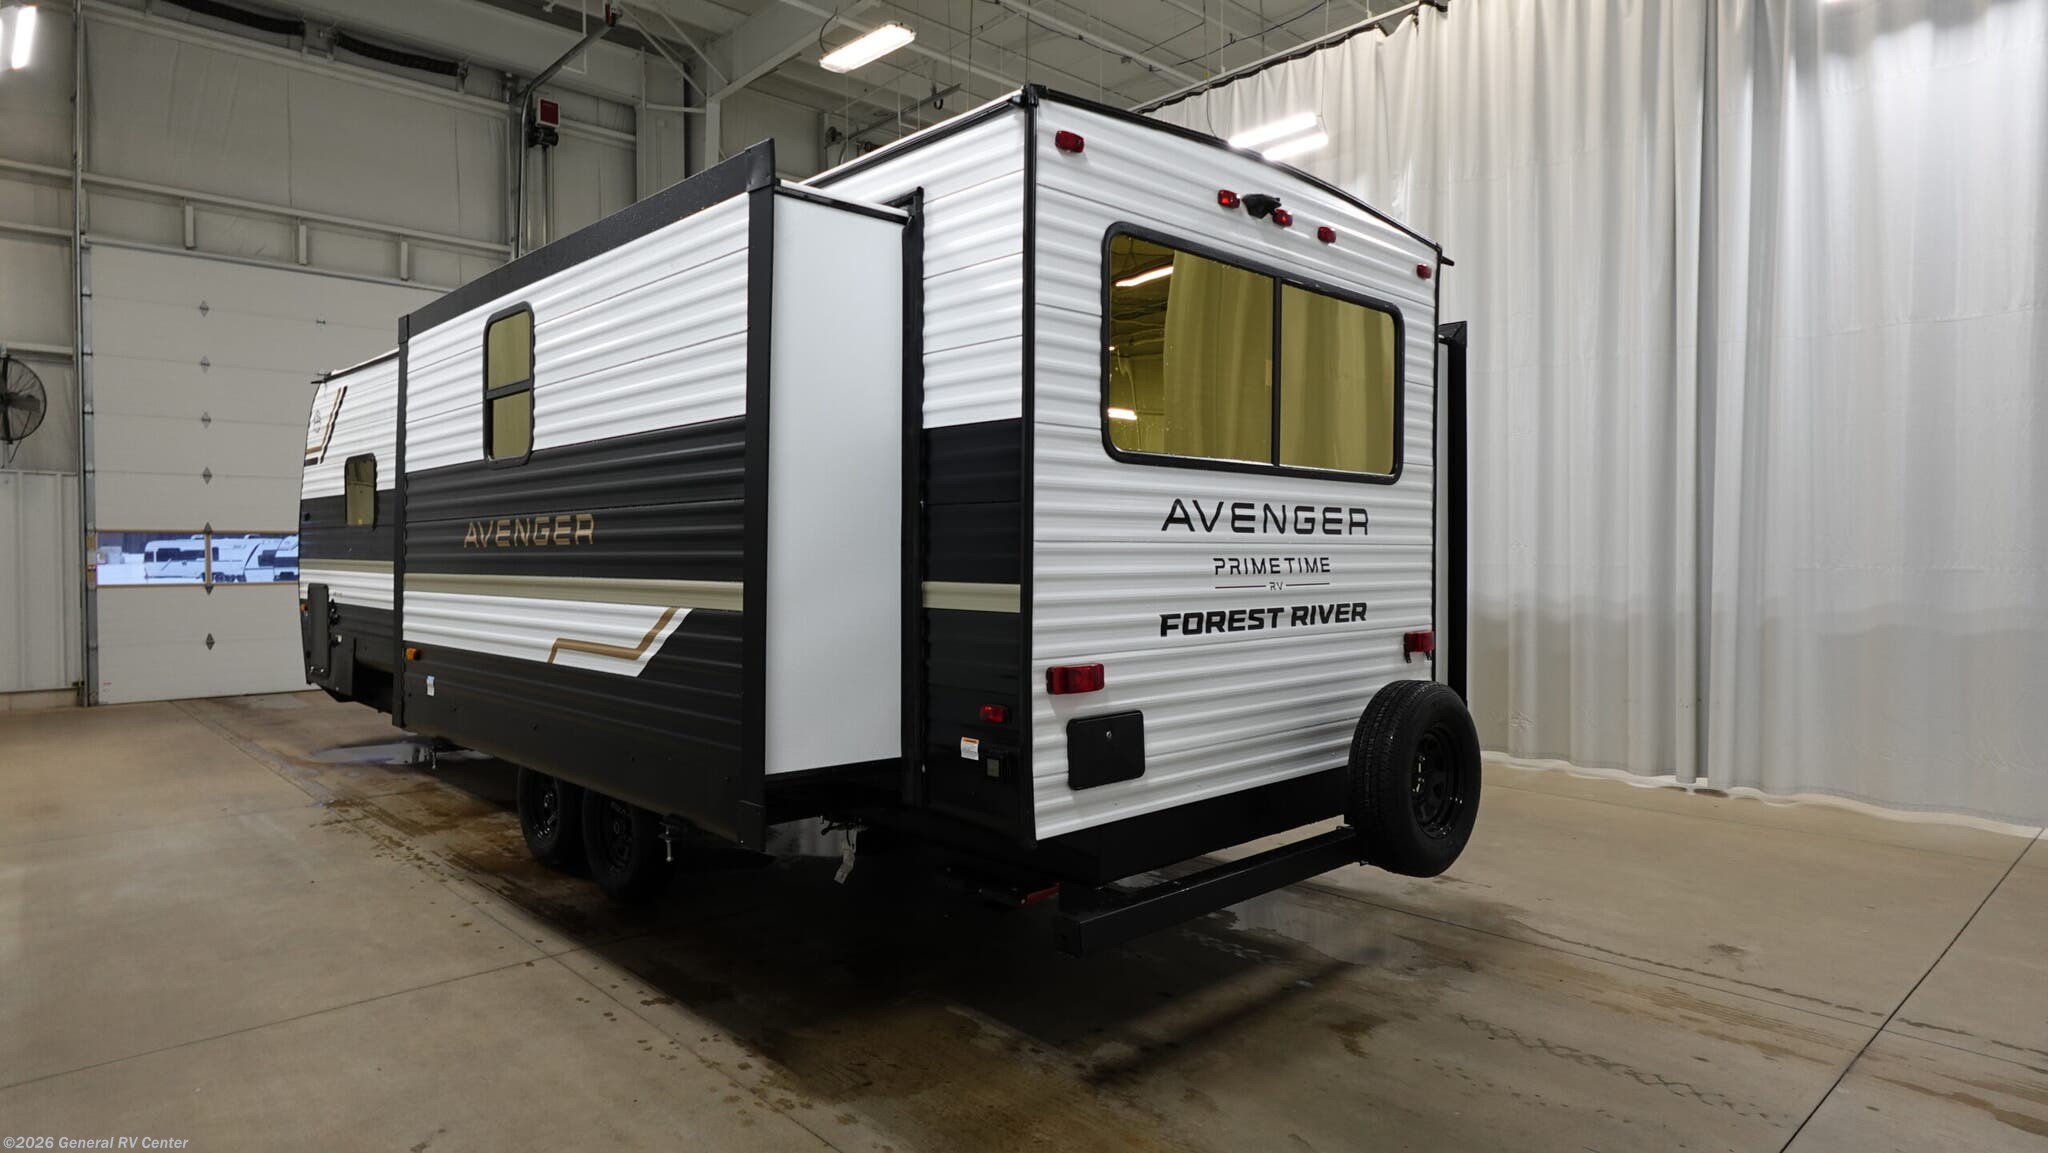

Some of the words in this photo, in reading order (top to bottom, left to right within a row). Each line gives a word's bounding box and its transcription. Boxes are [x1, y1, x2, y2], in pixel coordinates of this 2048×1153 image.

[464, 513, 595, 548] AVENGER
[1161, 498, 1369, 535] AVENGER
[1269, 581, 1283, 591] RV
[1159, 607, 1284, 637] FOREST
[1291, 602, 1367, 627] RIVER
